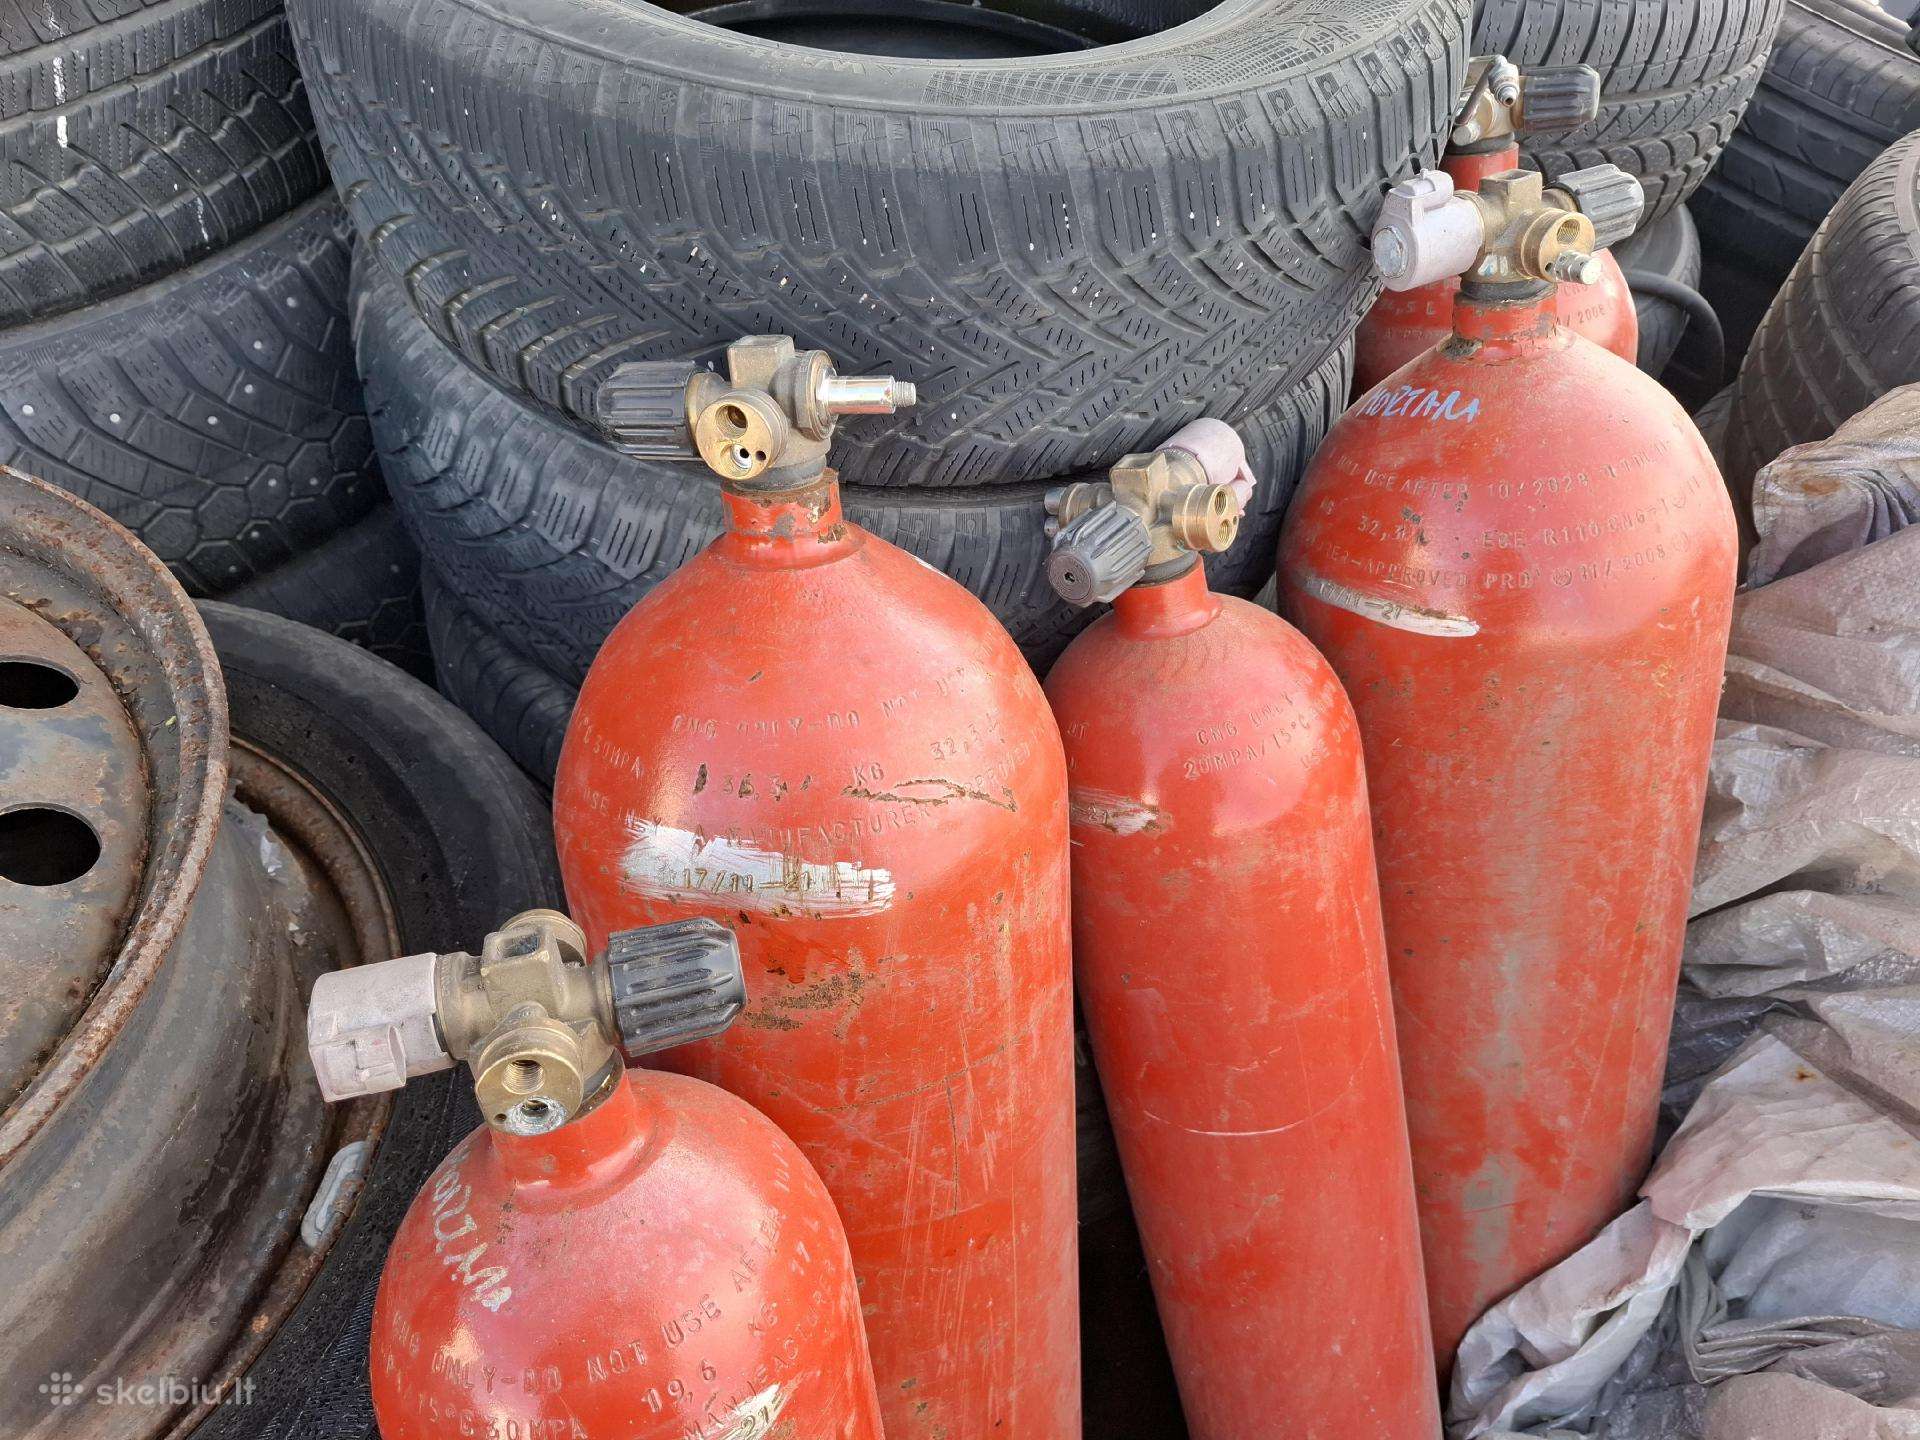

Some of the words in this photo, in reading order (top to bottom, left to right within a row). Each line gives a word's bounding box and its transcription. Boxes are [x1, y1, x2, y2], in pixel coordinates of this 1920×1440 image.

[1364, 468, 1397, 492] USE
[1401, 478, 1470, 500] AFTER
[1197, 719, 1239, 747] CNG
[586, 1338, 649, 1385] NOT
[661, 1294, 723, 1351] USE
